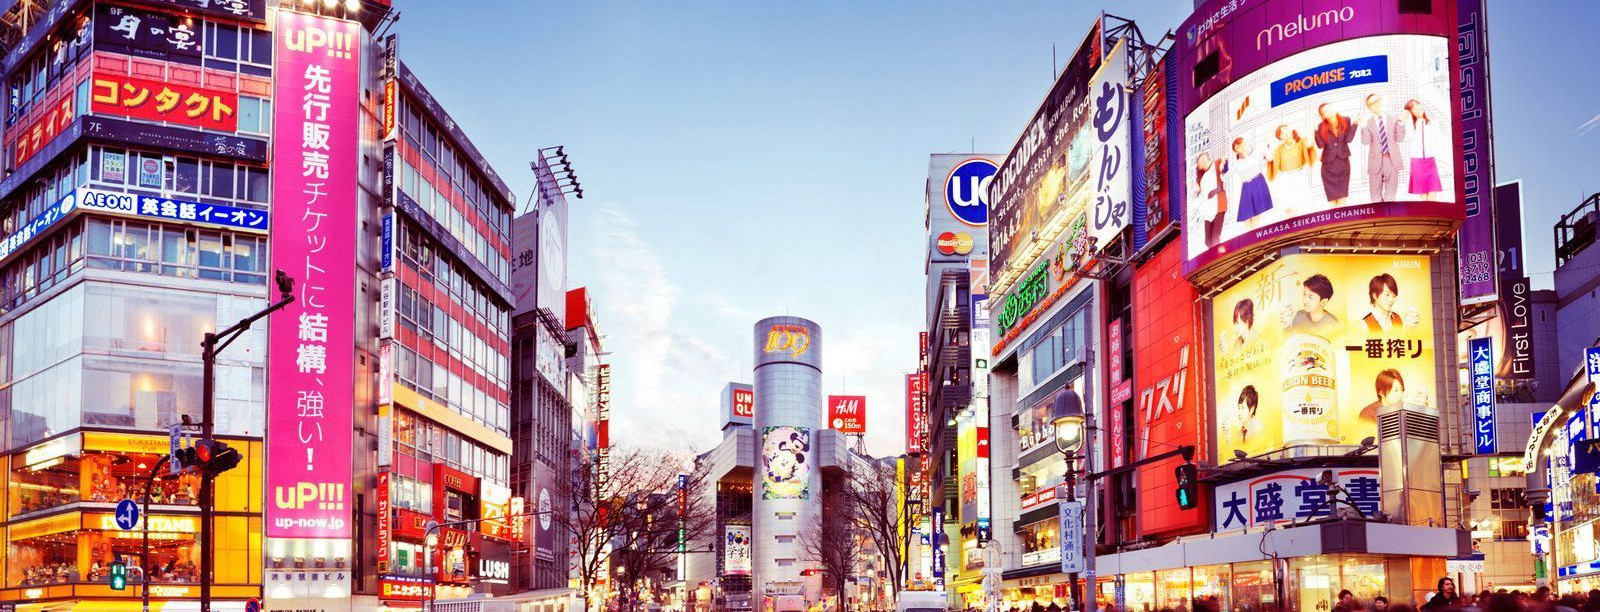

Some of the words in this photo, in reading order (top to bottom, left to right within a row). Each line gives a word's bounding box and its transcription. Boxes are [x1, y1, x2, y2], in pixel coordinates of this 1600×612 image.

[1256, 5, 1354, 51] melumo
[1284, 67, 1345, 96] PROMISE
[94, 79, 234, 122] コンタクト
[18, 96, 73, 164] プライス
[89, 122, 102, 133] 7F
[991, 112, 1047, 210] OLDCODEX
[1025, 146, 1052, 184] within
[1054, 122, 1069, 145] the
[1093, 81, 1126, 231] もんじゃ
[83, 192, 132, 211] AEON
[141, 197, 264, 228] 英会話イーオン
[1256, 223, 1290, 238] WAKASA
[1292, 212, 1332, 229] SEIKATSU
[1333, 207, 1376, 220] CHANNEL
[1393, 259, 1421, 270] KIRIN
[1464, 263, 1489, 276] 3719
[1466, 251, 1488, 265] (03)
[1464, 273, 1490, 285] 2468
[1511, 281, 1529, 329] Love
[763, 330, 811, 358] 109
[1345, 338, 1423, 359] 一番搾り
[1511, 332, 1530, 374] First
[1311, 375, 1334, 388] BEER
[835, 399, 858, 415] H&M
[1294, 407, 1323, 415] 一番搾り
[1474, 346, 1493, 448] 大盛堂商事ビル
[844, 422, 862, 430] 150m
[910, 376, 921, 450] Essential
[275, 482, 344, 511] uP!!!
[275, 516, 345, 531] up-now.jp
[479, 559, 509, 579] LUSH
